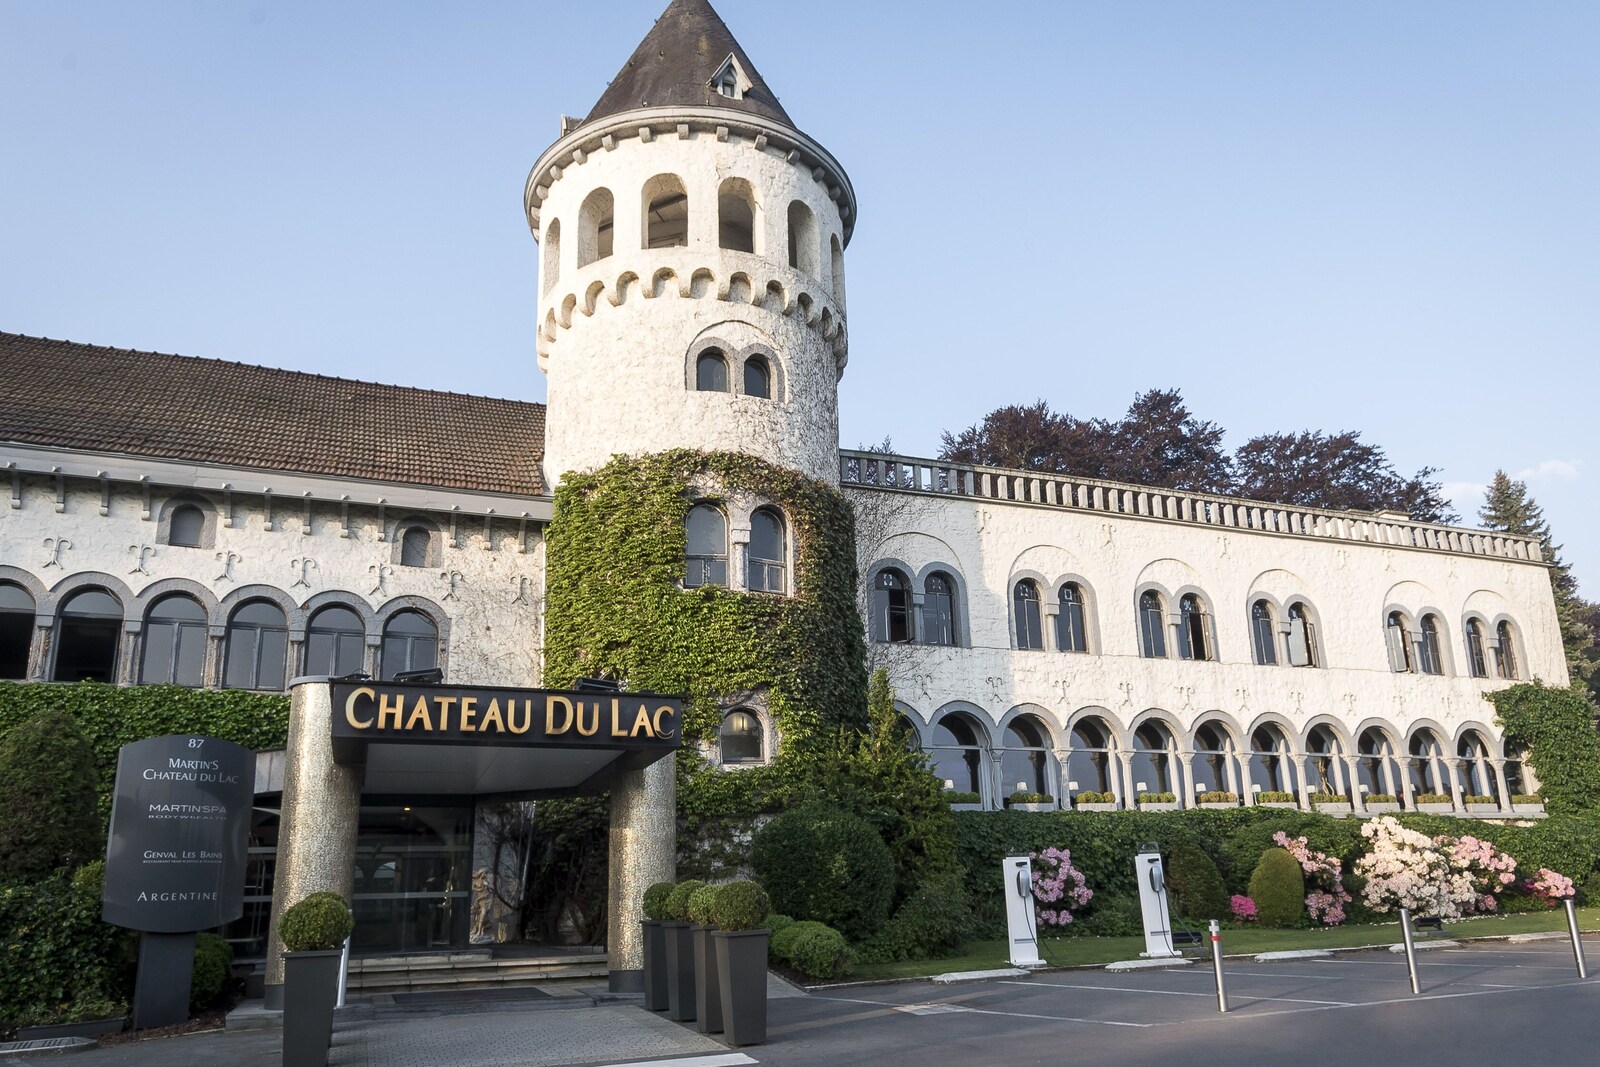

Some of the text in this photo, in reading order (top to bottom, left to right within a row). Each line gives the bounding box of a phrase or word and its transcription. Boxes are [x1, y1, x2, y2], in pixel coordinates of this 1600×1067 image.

[345, 687, 675, 738] CHATEAU DU LAC
[188, 739, 204, 748] 87
[169, 758, 219, 770] MARTIN'S
[143, 769, 239, 784] CHATEAU DU LAC
[143, 850, 223, 859] GENVAL LES BAINS
[137, 891, 218, 902] ARGENTINE
